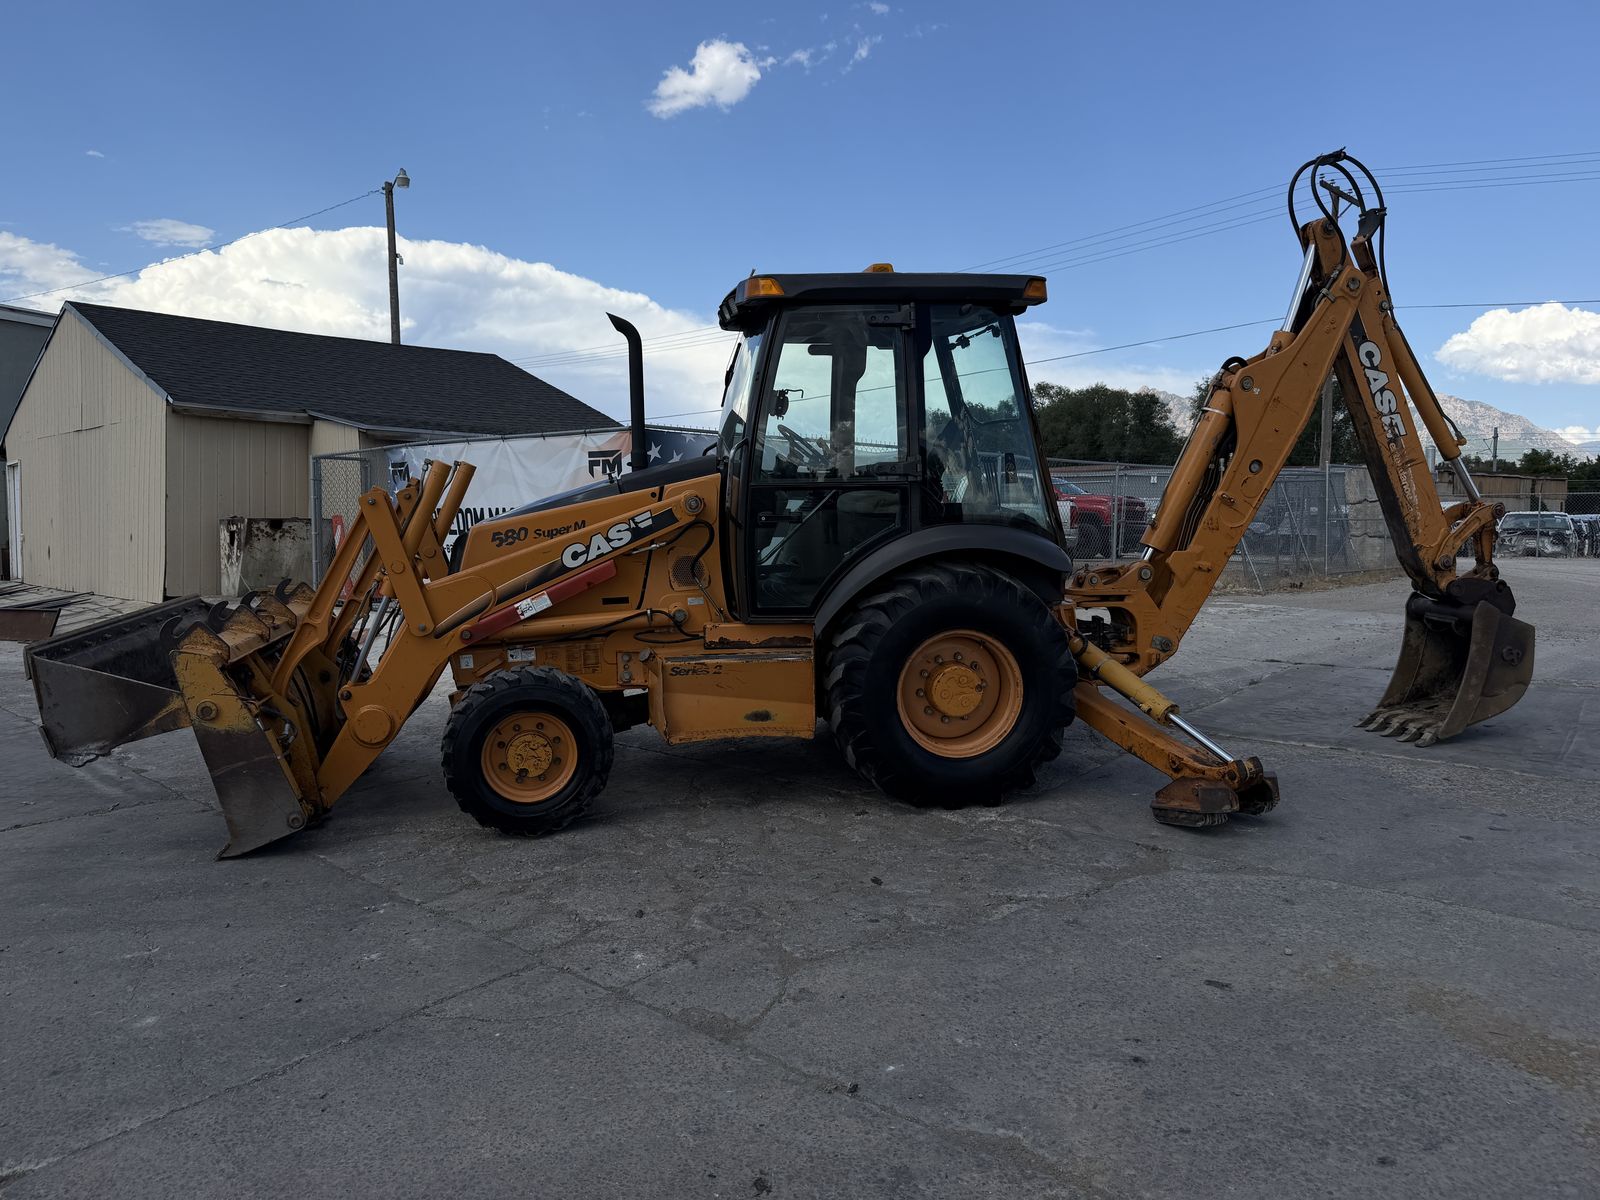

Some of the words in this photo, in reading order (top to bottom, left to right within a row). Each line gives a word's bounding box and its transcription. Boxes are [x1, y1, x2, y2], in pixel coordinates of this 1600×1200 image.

[1358, 340, 1408, 439] CASE
[587, 450, 623, 479] FM
[491, 526, 529, 548] 580
[533, 525, 572, 540] Super
[573, 519, 586, 531] M
[561, 511, 653, 569] CASE
[669, 665, 710, 676] Series
